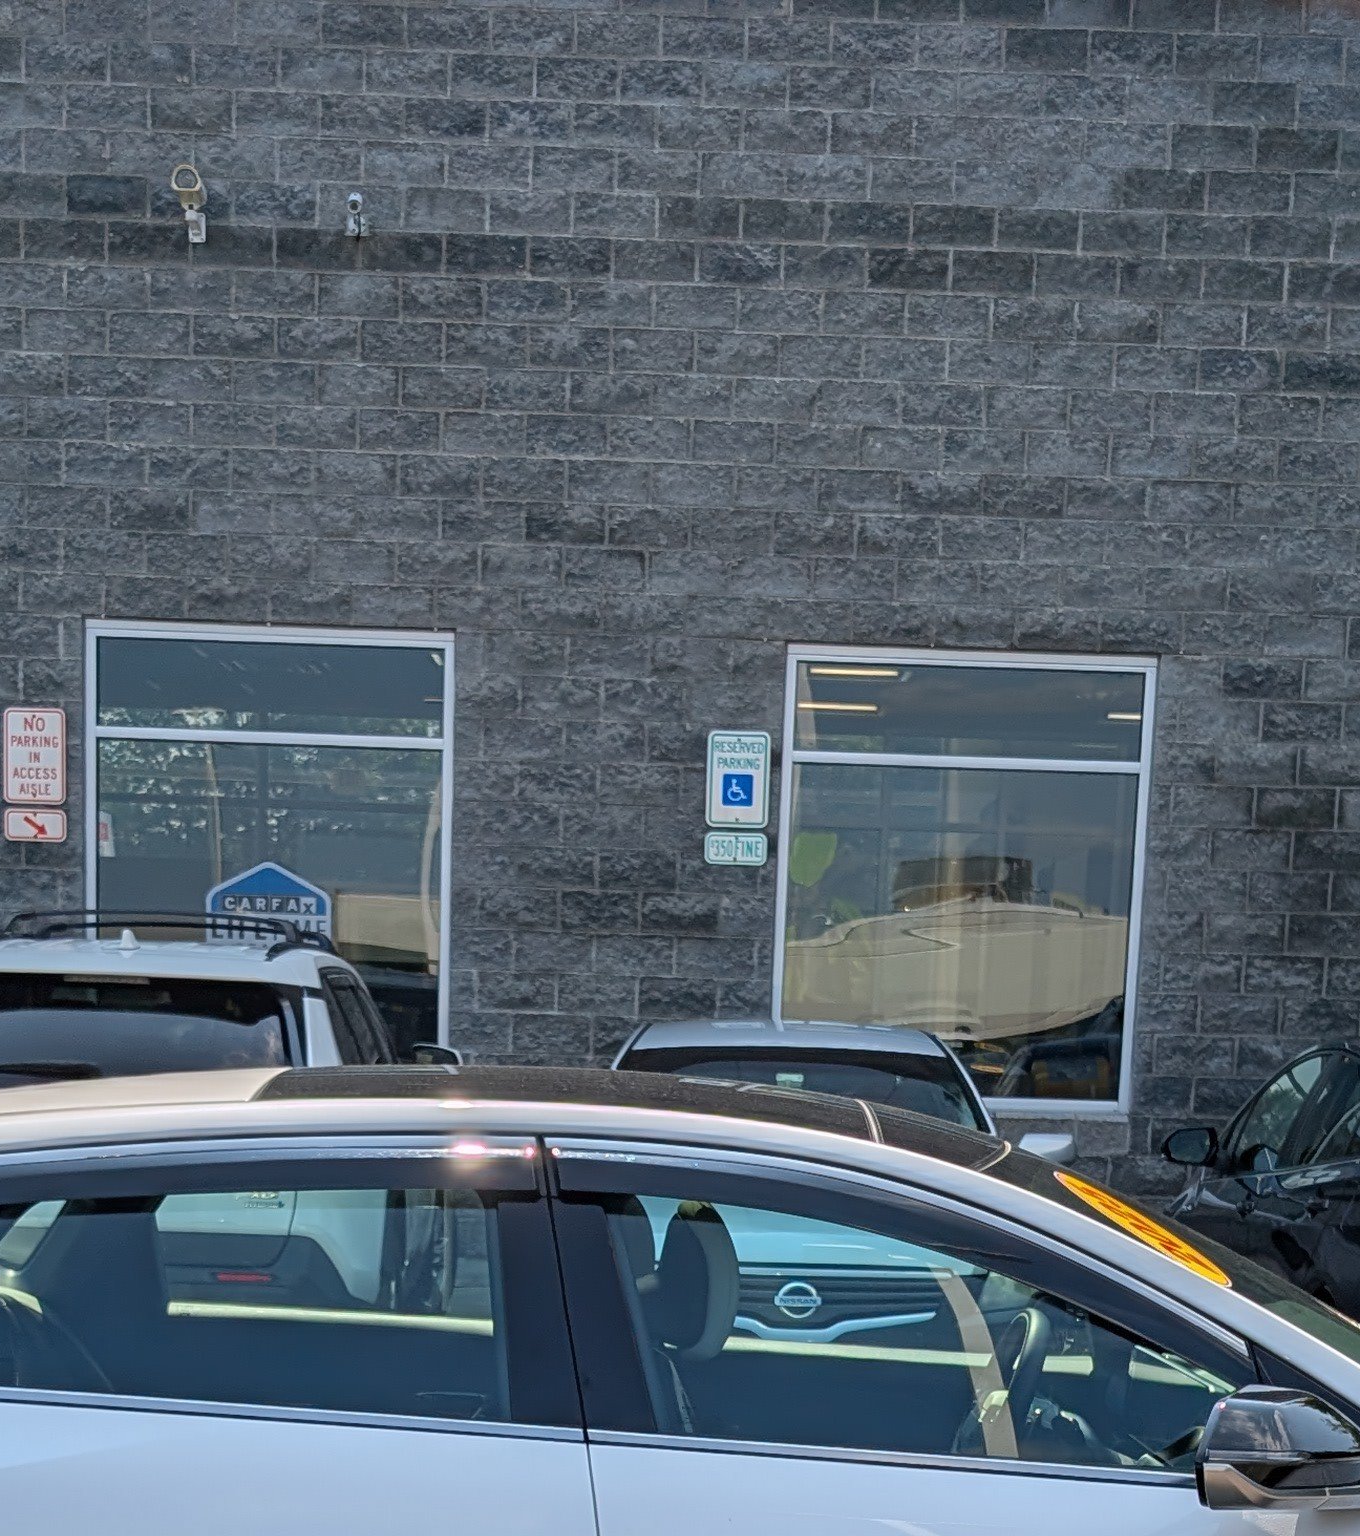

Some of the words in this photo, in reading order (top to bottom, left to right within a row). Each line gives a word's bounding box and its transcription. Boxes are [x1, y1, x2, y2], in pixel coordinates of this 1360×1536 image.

[23, 717, 46, 732] NO
[10, 735, 59, 748] PARKING
[713, 741, 765, 754] RESERVED
[28, 751, 41, 763] IN
[717, 757, 761, 770] PARKING
[12, 767, 58, 780] ACCESS
[19, 783, 52, 796] AISLE
[734, 840, 761, 858] FINE
[223, 896, 315, 914] CARFAX
